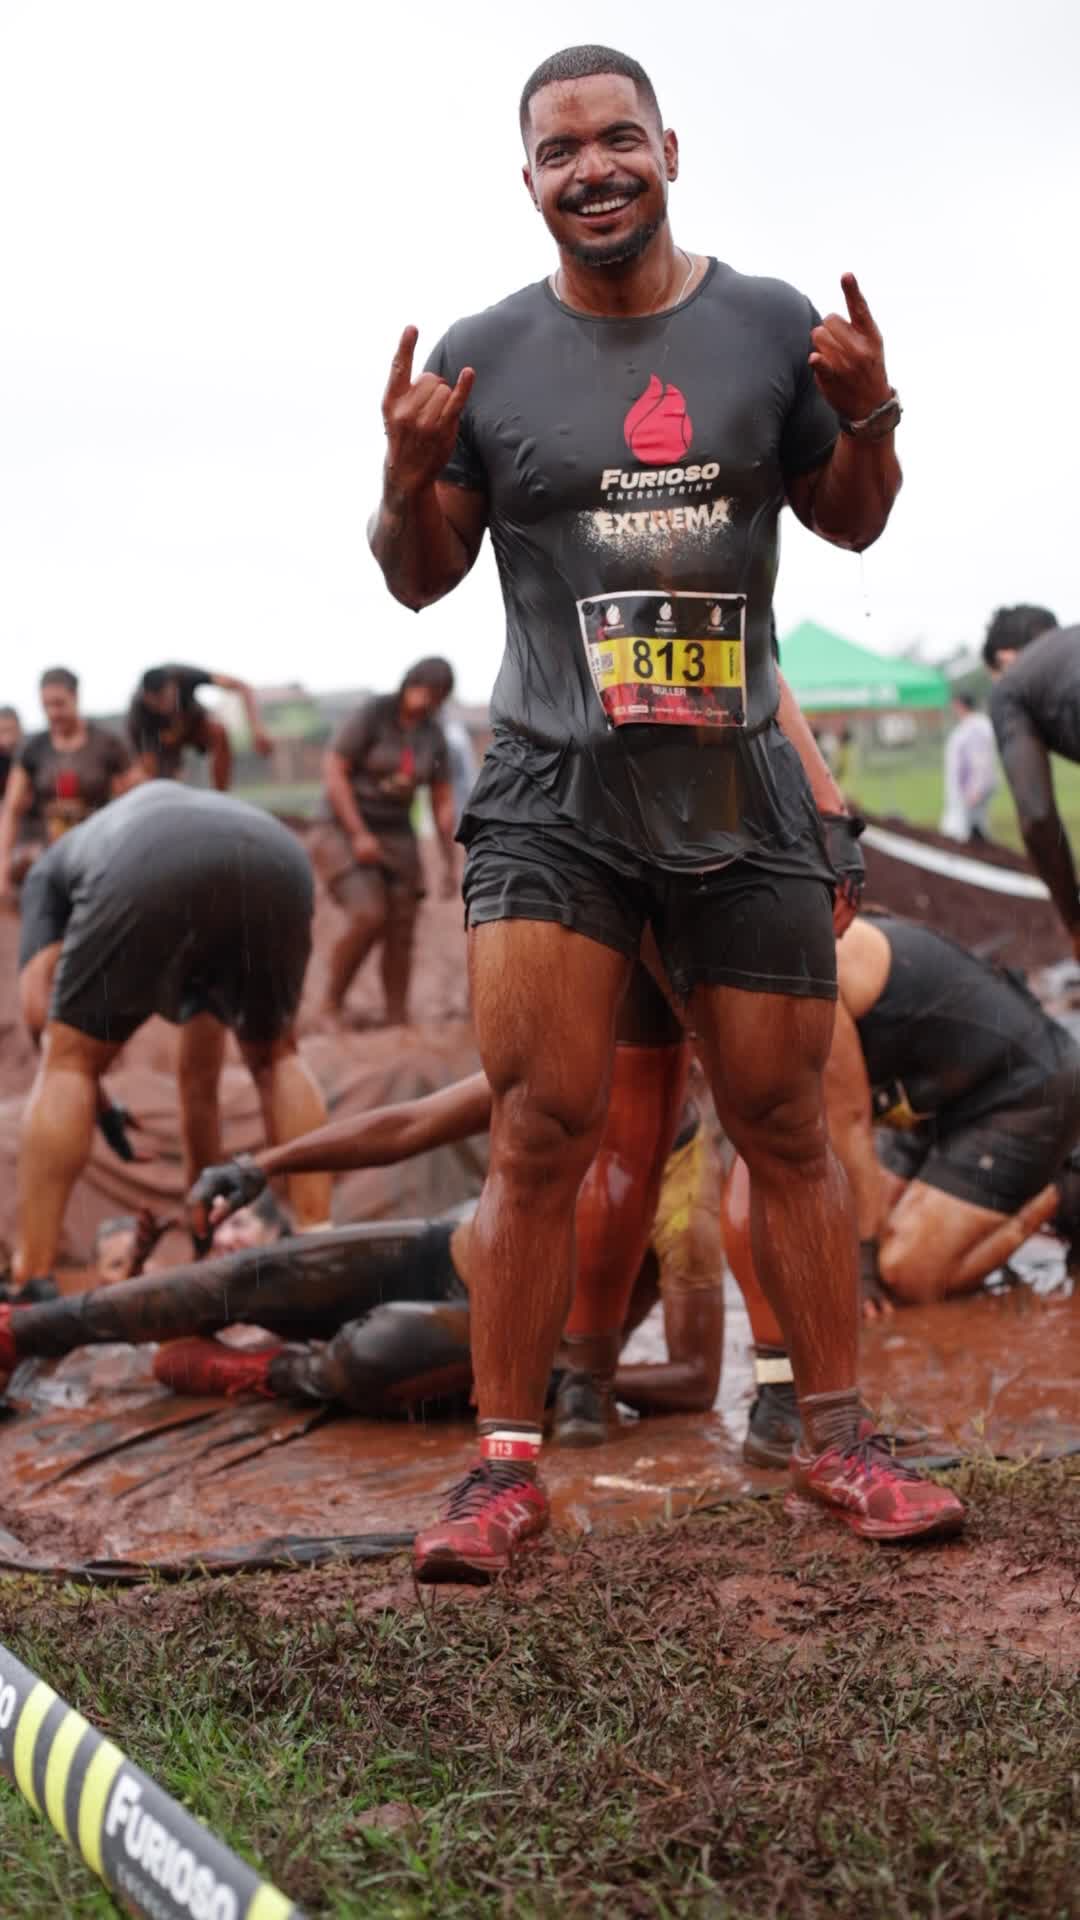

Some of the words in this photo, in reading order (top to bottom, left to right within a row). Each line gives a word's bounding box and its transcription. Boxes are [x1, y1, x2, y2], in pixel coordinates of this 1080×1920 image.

[600, 462, 720, 490] FURIOSO
[606, 490, 663, 501] ENERGY
[669, 482, 713, 496] DRINK
[593, 499, 731, 537] EXTREMA
[632, 639, 706, 682] 813
